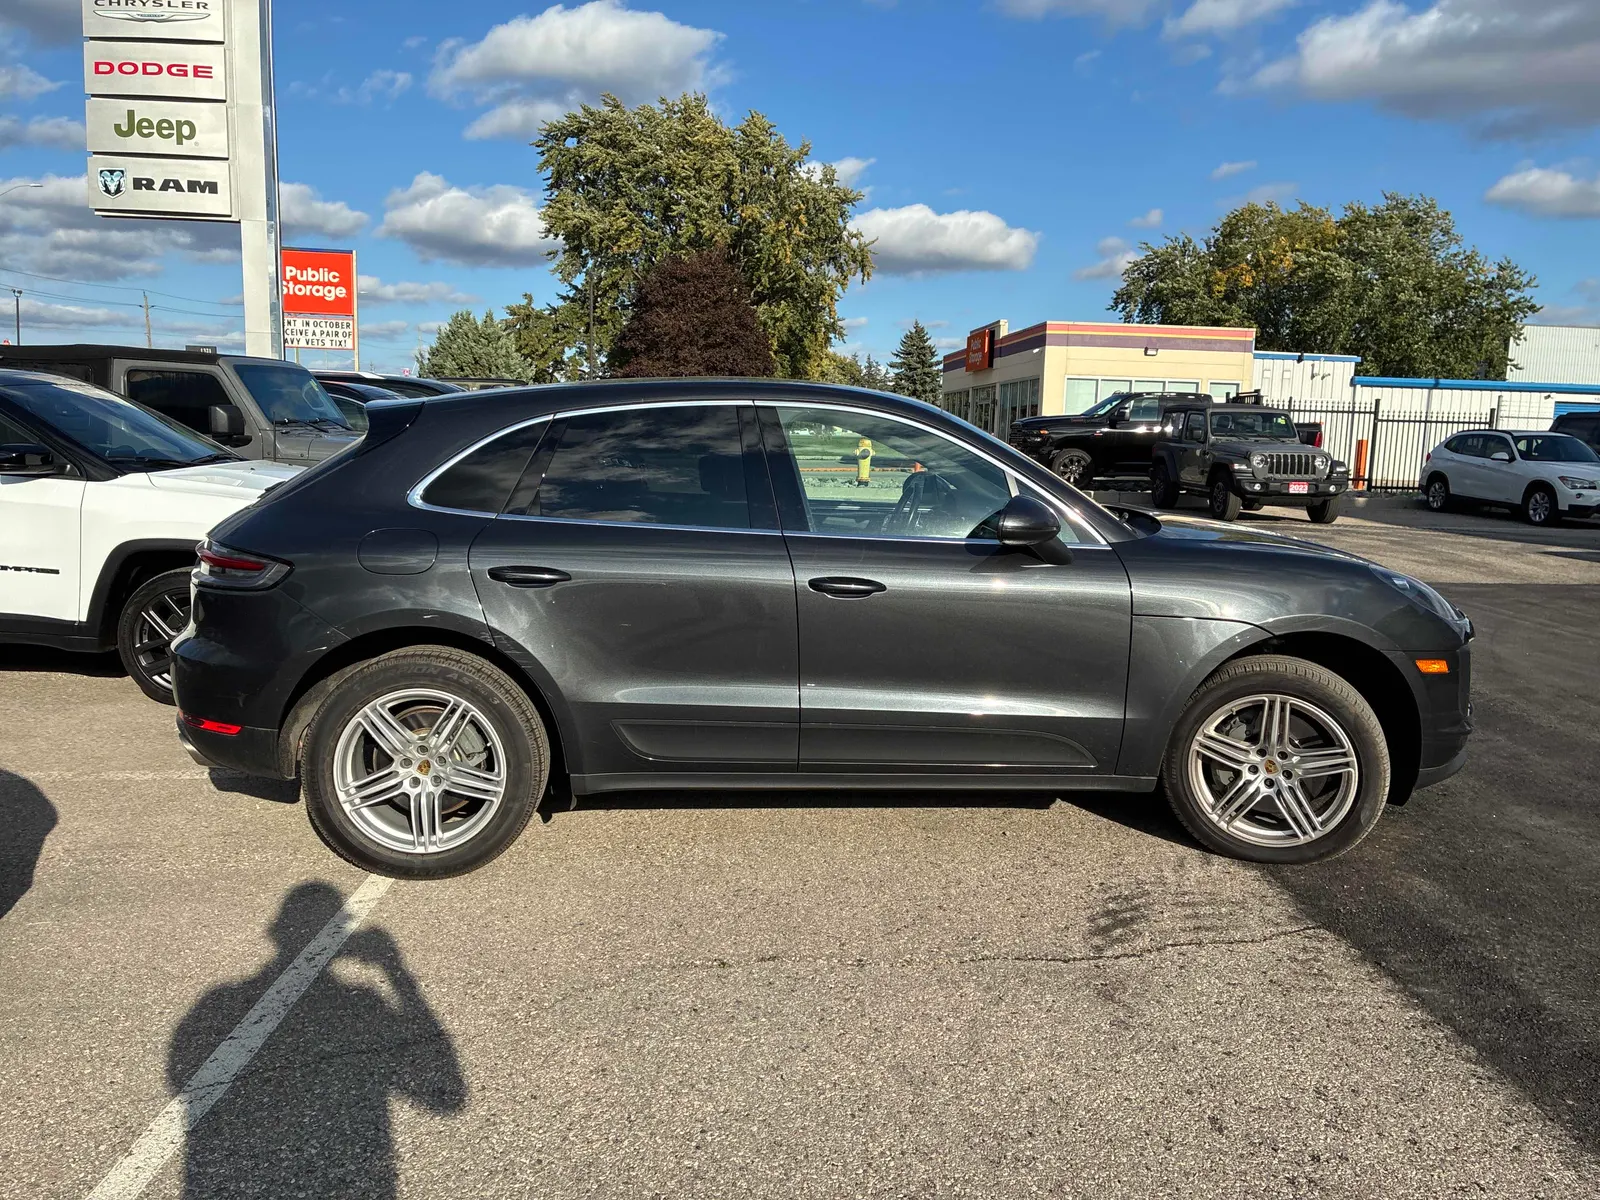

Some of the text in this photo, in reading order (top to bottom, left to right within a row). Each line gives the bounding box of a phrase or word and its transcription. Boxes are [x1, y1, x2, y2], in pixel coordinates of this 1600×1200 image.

[94, 0, 209, 9] CHRYSLER
[94, 61, 213, 79] DODGE
[114, 109, 197, 145] Jeep
[132, 177, 219, 195] RAM
[285, 266, 340, 282] Public
[283, 319, 351, 329] NT IN OCTOBER
[311, 329, 317, 337] A
[319, 330, 340, 338] PAIR
[341, 330, 352, 339] OF
[304, 338, 326, 347] VETS
[329, 339, 347, 348] TIX!
